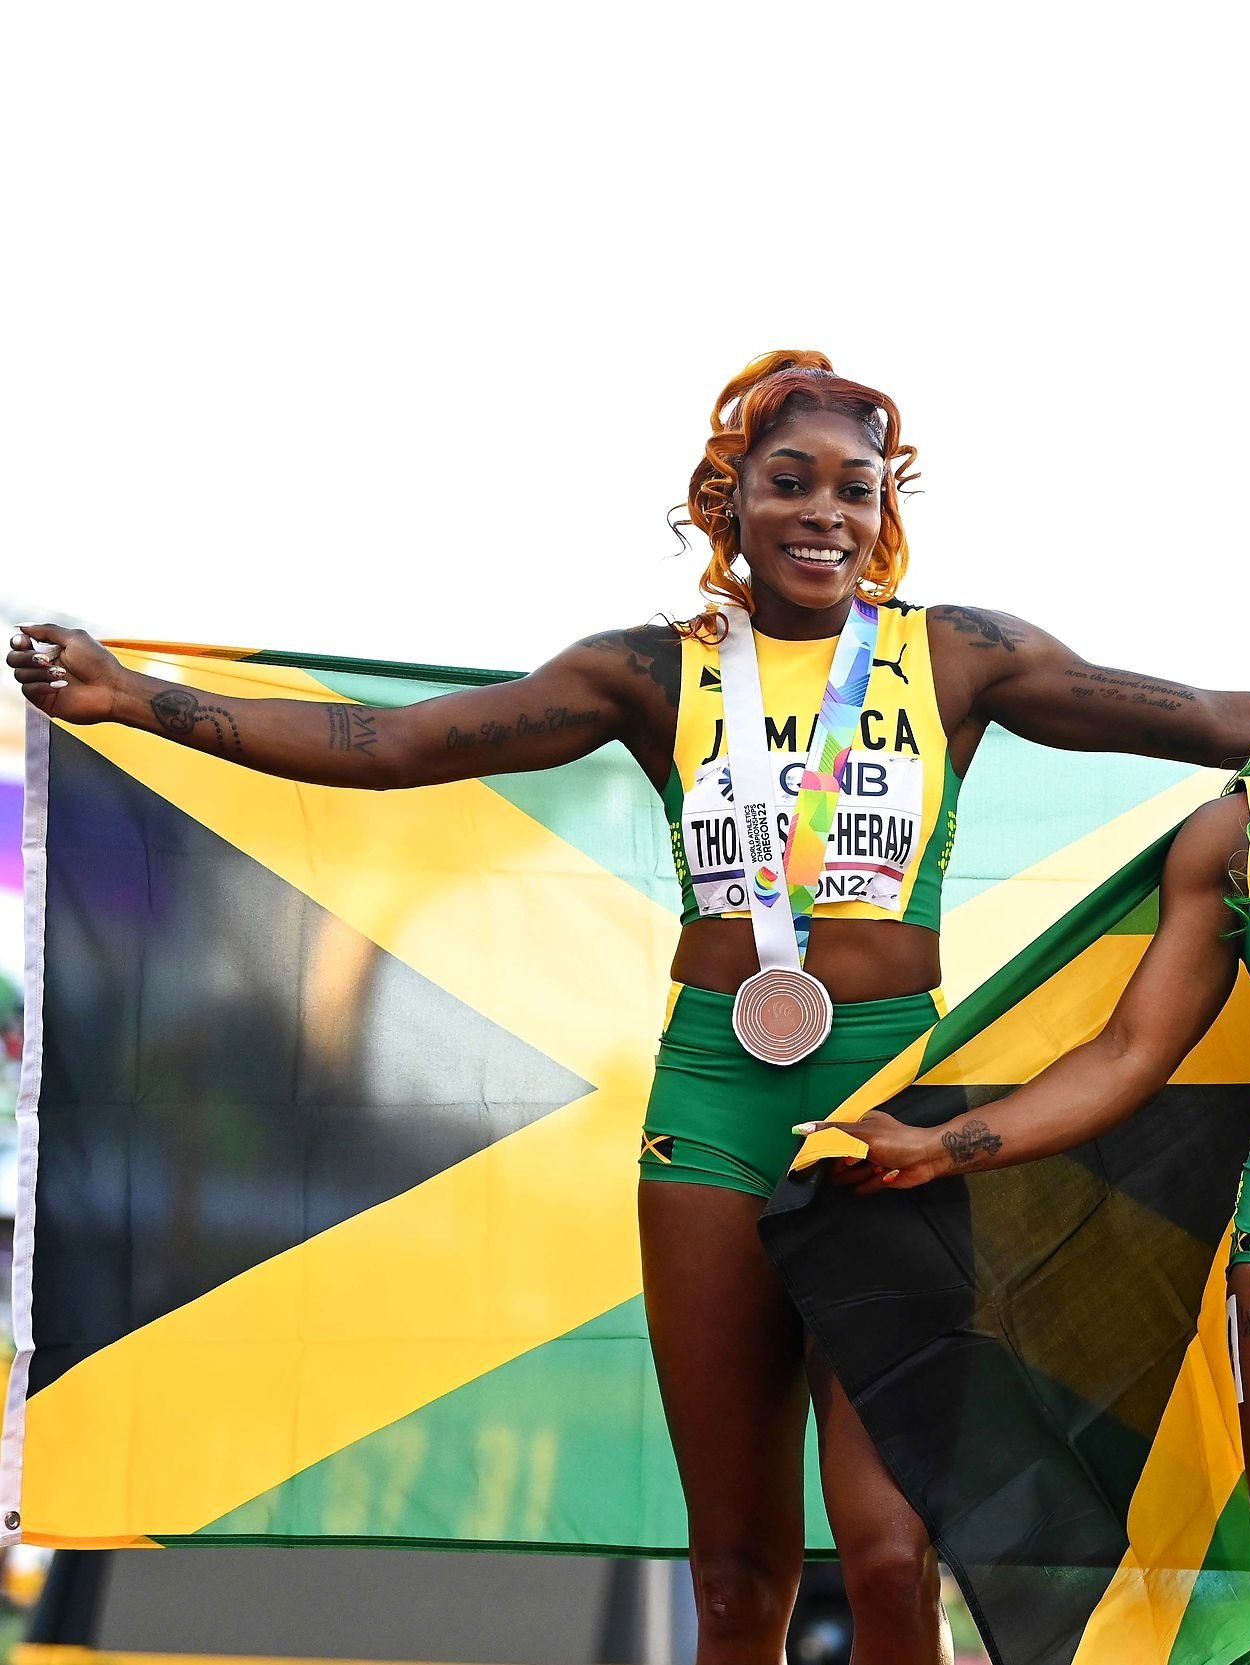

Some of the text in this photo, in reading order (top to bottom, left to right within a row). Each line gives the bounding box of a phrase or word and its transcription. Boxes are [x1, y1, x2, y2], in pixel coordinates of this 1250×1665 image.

[701, 709, 920, 765] JMCA
[744, 804, 758, 864] WORLD ATHLETICS
[750, 804, 764, 862] CHAMPIONSHIPS
